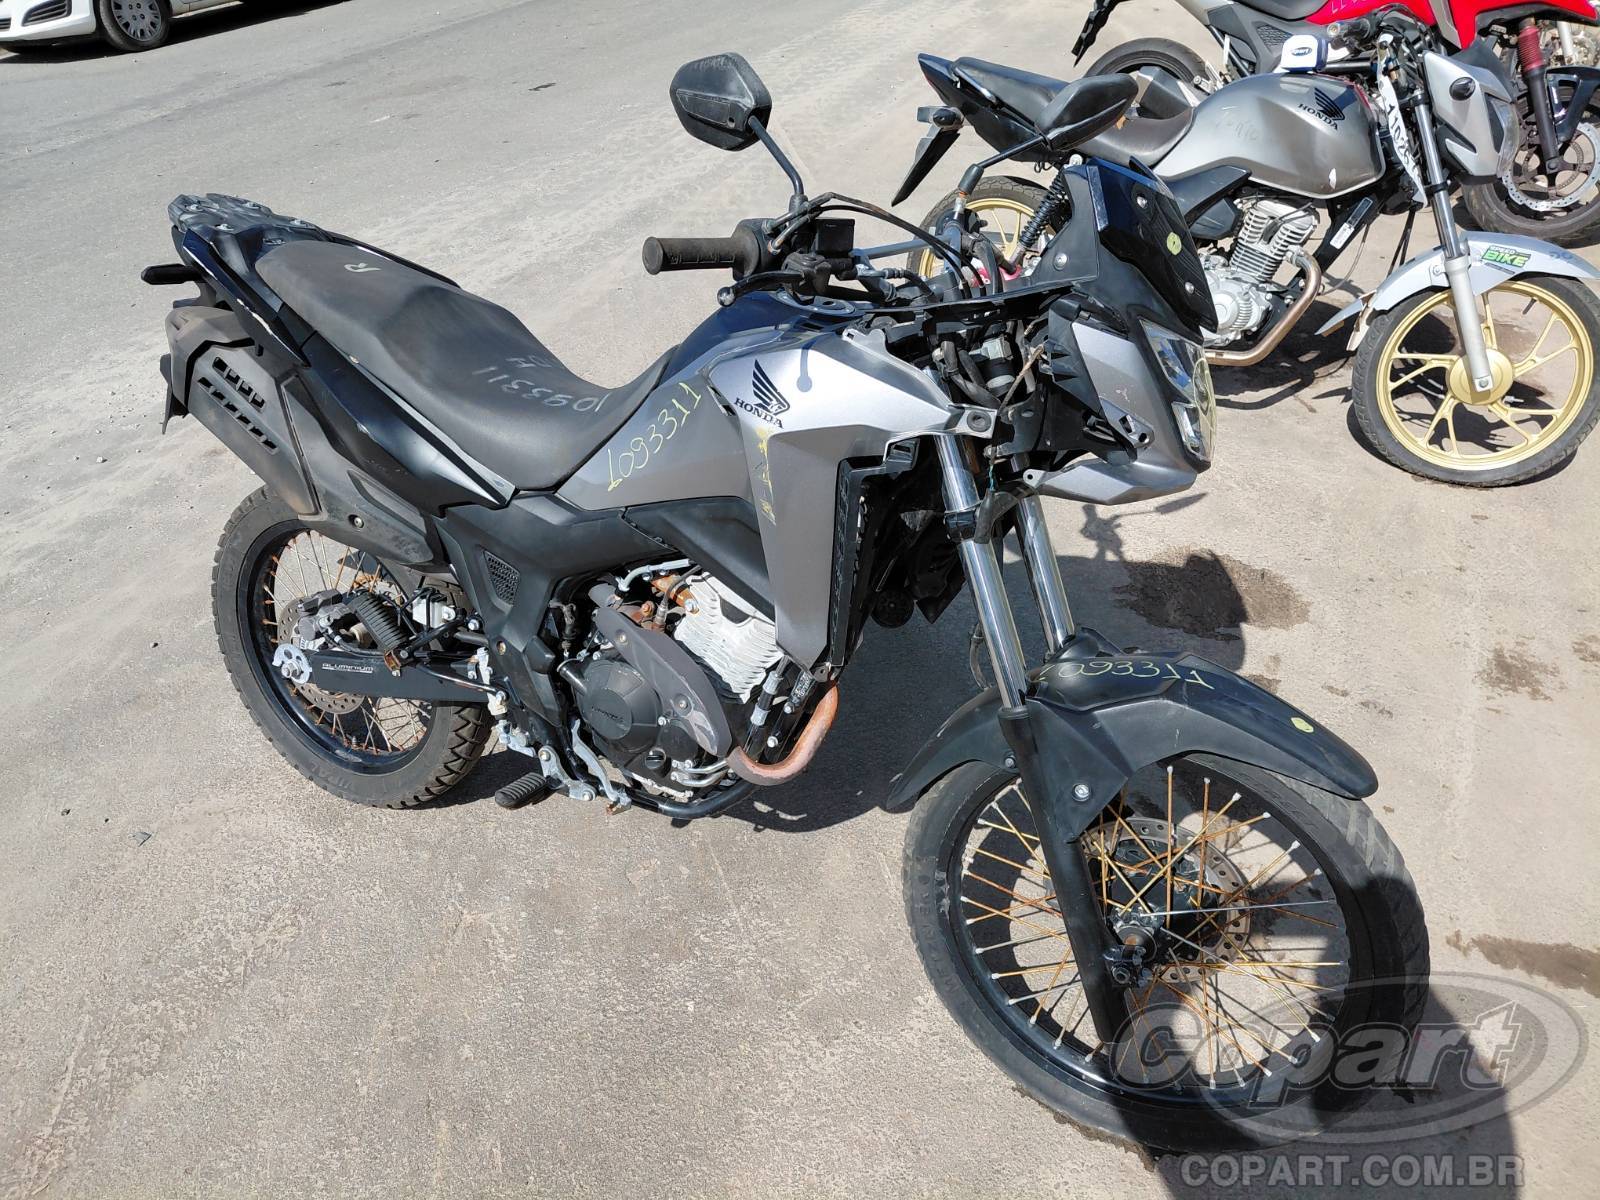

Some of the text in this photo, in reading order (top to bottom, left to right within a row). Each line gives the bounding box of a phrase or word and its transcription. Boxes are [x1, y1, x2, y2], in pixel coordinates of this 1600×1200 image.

[1298, 103, 1339, 131] HONDA
[1483, 249, 1527, 268] BIKE
[471, 365, 612, 413] 1093311
[734, 398, 784, 429] HONDA
[607, 382, 702, 492] 1093311
